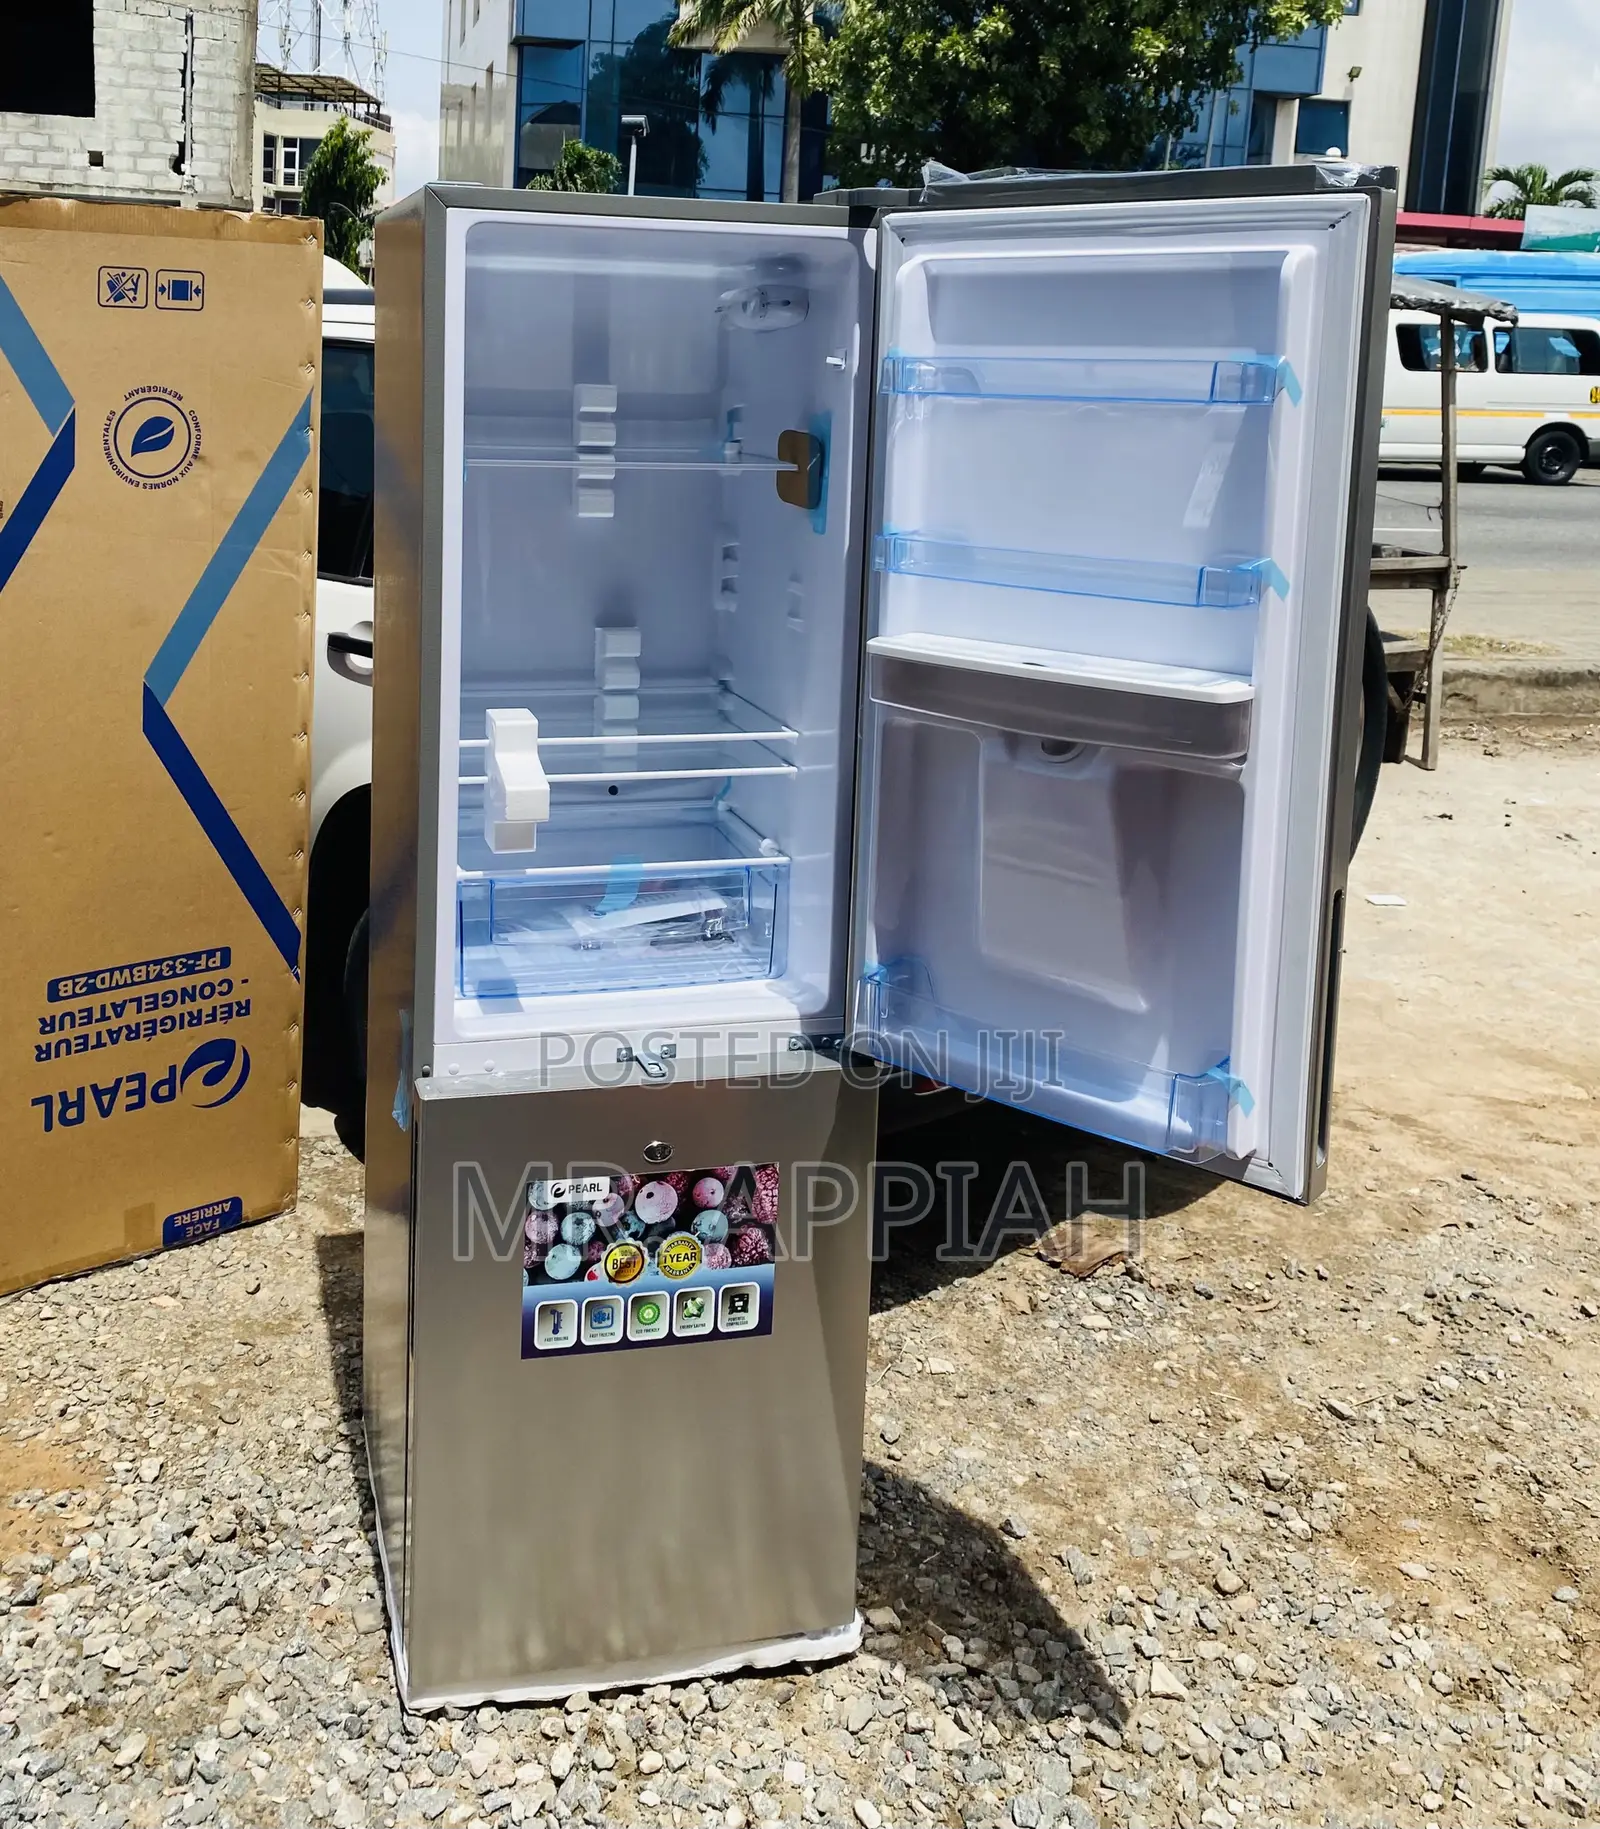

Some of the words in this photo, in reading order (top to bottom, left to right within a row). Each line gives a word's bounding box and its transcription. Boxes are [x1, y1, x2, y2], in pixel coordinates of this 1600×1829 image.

[188, 409, 202, 460] CONFORME
[178, 460, 194, 478] AUX
[142, 475, 180, 490] NORMES
[57, 950, 222, 998] PF-334BWD-2B
[37, 977, 235, 1036] CONGELATEUR
[33, 997, 251, 1063] RÉFRIGÉRATEUR
[30, 1063, 178, 1133] PEARL
[568, 1182, 603, 1194] PEARL
[185, 1219, 221, 1238] FACE
[612, 1255, 637, 1270] BEST
[669, 1252, 698, 1263] YEAR
